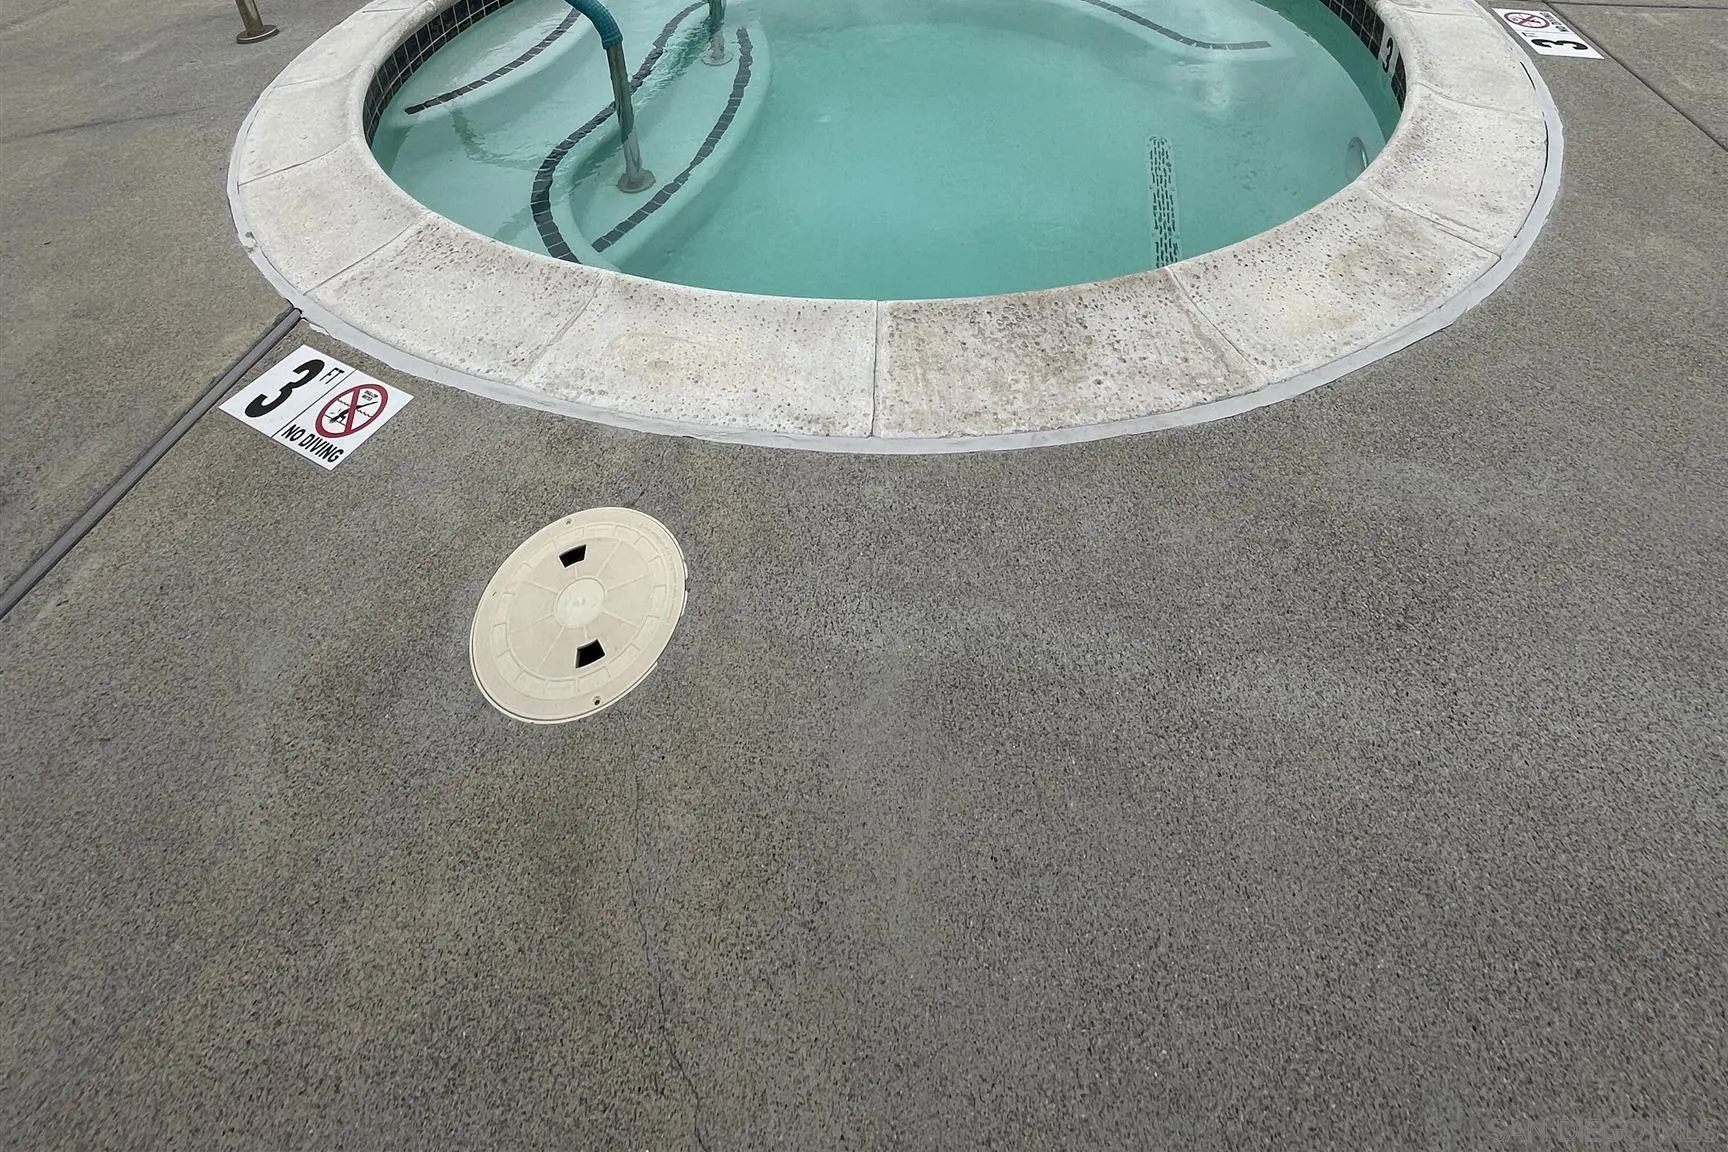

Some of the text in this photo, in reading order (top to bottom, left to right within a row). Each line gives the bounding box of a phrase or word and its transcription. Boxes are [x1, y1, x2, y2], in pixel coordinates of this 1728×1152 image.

[1531, 39, 1588, 50] 3
[244, 359, 344, 418] 3 FT
[281, 424, 344, 463] NO DIVING
